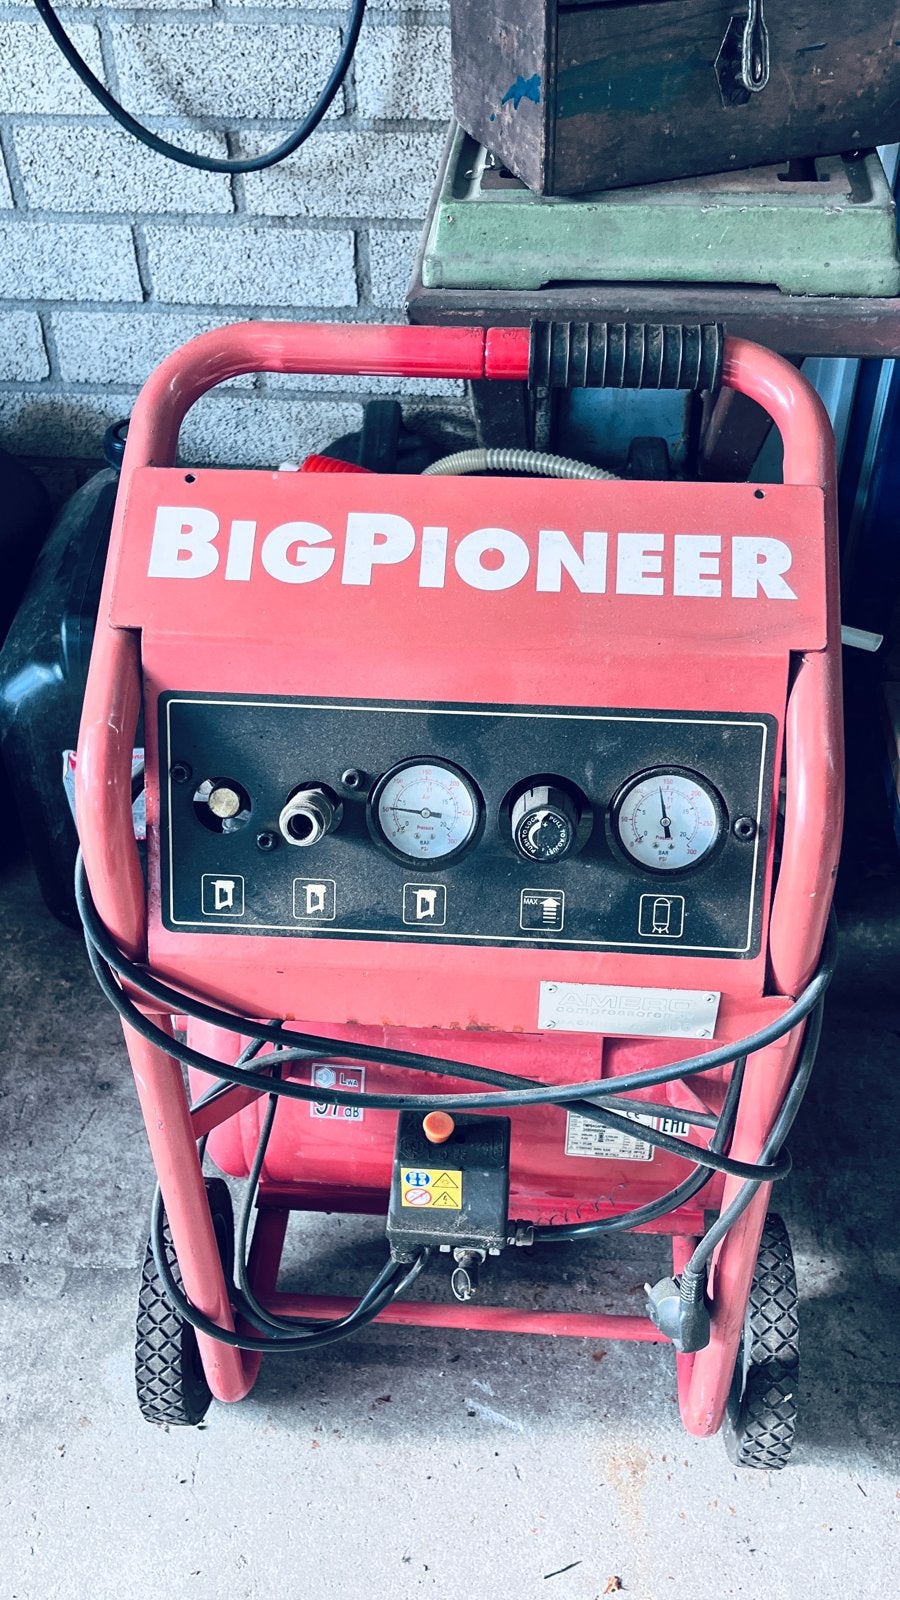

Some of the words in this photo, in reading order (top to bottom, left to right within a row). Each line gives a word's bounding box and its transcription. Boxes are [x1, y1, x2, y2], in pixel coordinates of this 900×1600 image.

[147, 504, 798, 600] BIGPIONEER
[548, 816, 563, 829] PULL
[559, 829, 566, 838] TO
[545, 838, 566, 856] ADJUST
